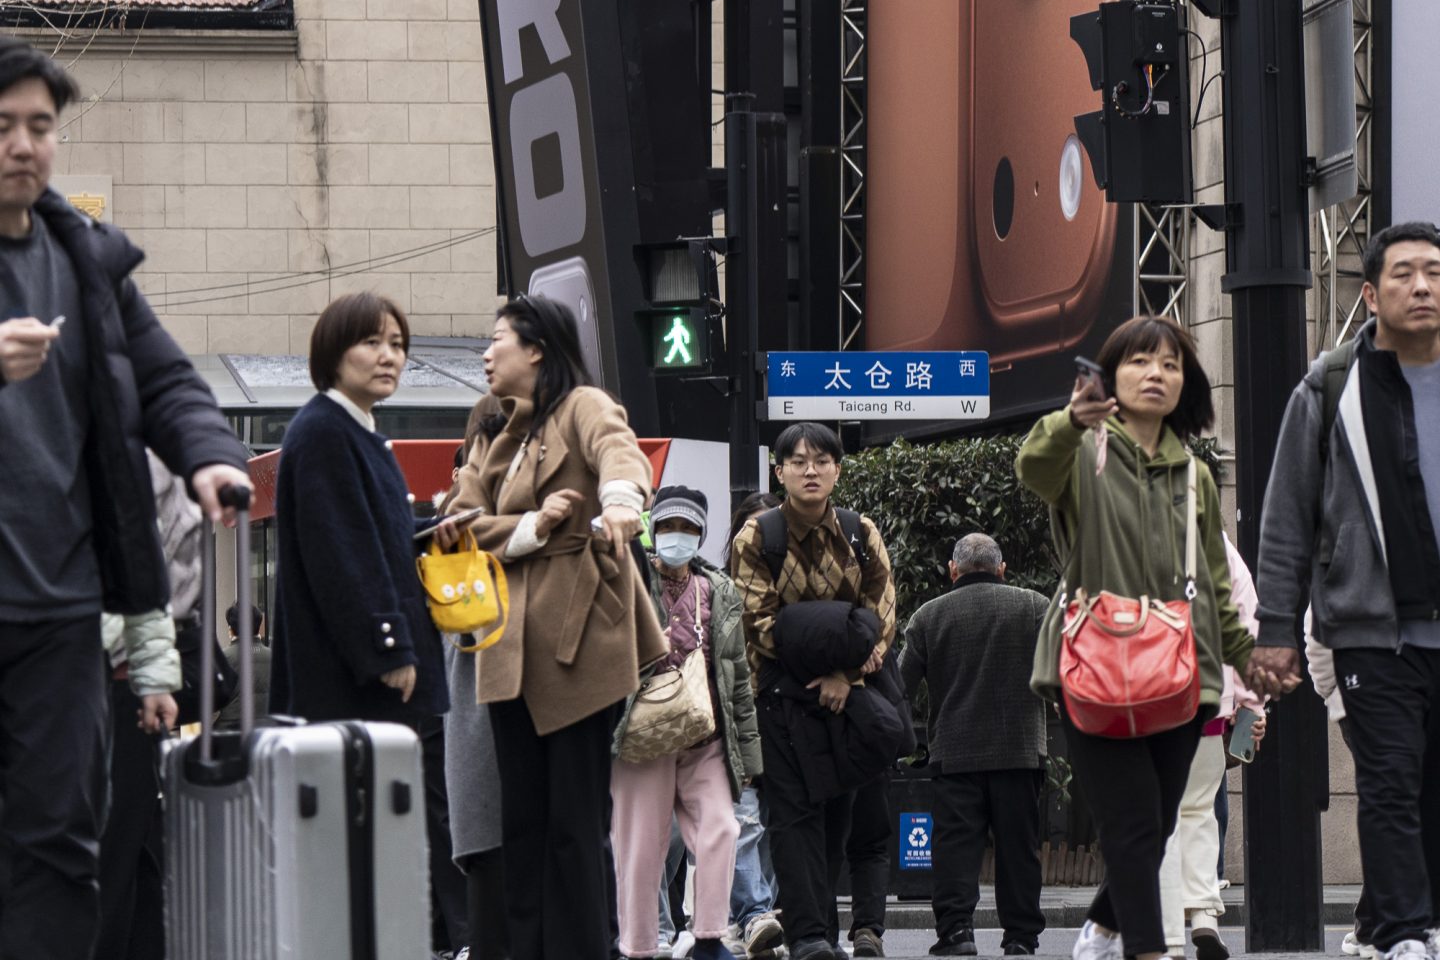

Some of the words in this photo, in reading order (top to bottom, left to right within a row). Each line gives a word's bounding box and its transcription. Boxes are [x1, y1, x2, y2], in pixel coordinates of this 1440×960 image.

[781, 360, 796, 377] 东
[824, 360, 933, 390] 太仓路
[959, 359, 976, 377] 西
[783, 401, 794, 415] E
[839, 401, 888, 414] Taicang
[894, 401, 916, 412] Rd.
[961, 400, 977, 414] W
